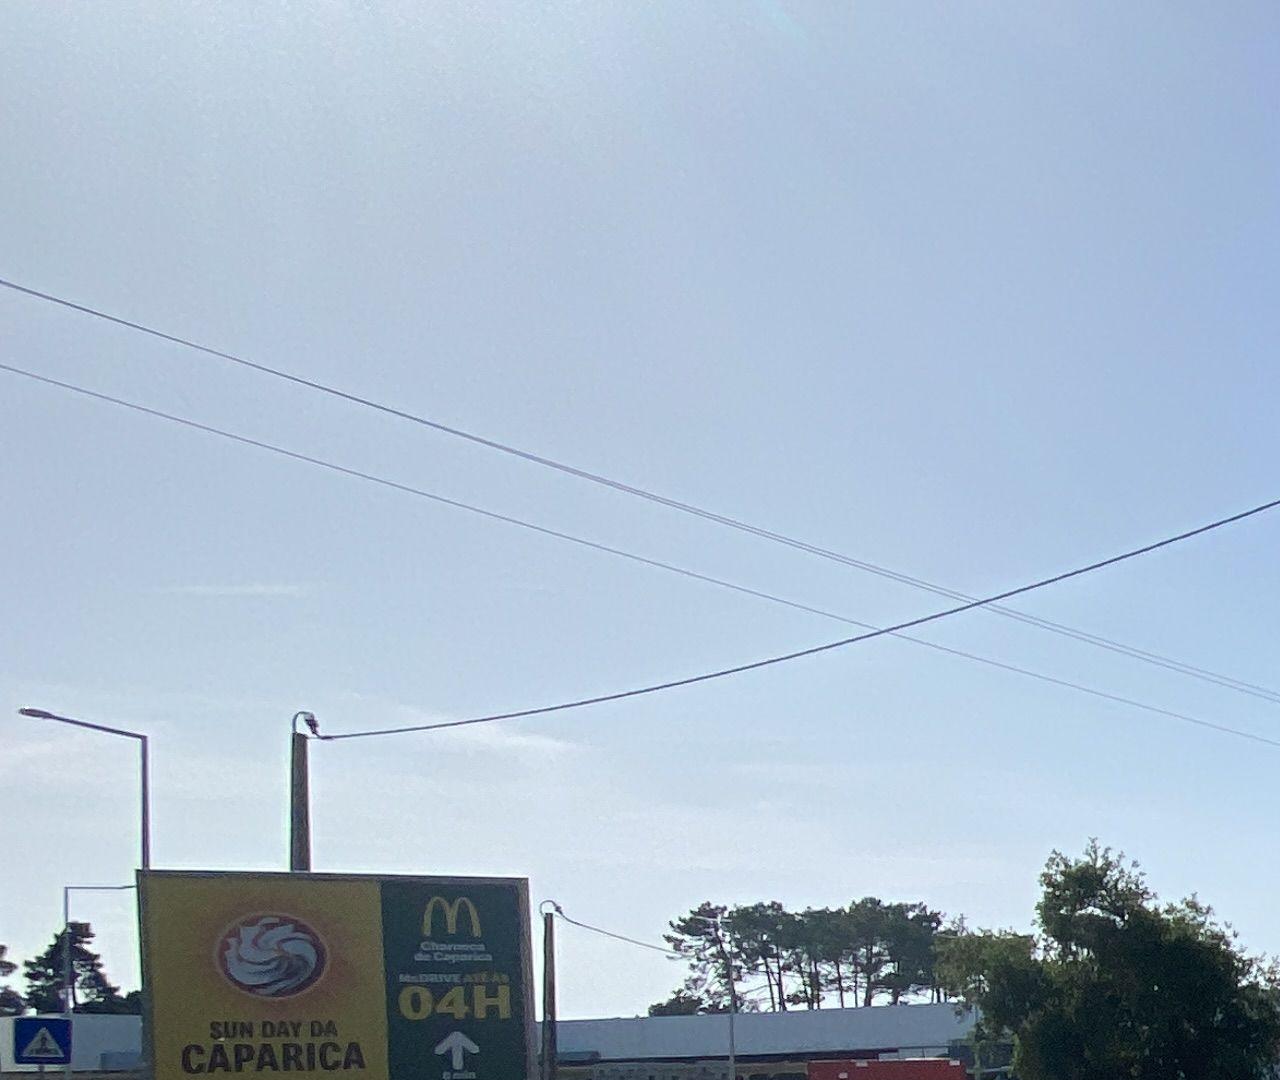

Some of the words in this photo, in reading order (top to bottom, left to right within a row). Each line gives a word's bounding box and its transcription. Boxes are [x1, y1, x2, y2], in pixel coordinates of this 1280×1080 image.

[398, 985, 511, 1020] 04H
[210, 1021, 254, 1039] SUN
[261, 1020, 302, 1038] DAY
[310, 1020, 338, 1037] DA
[181, 1042, 366, 1074] CAPARICA
